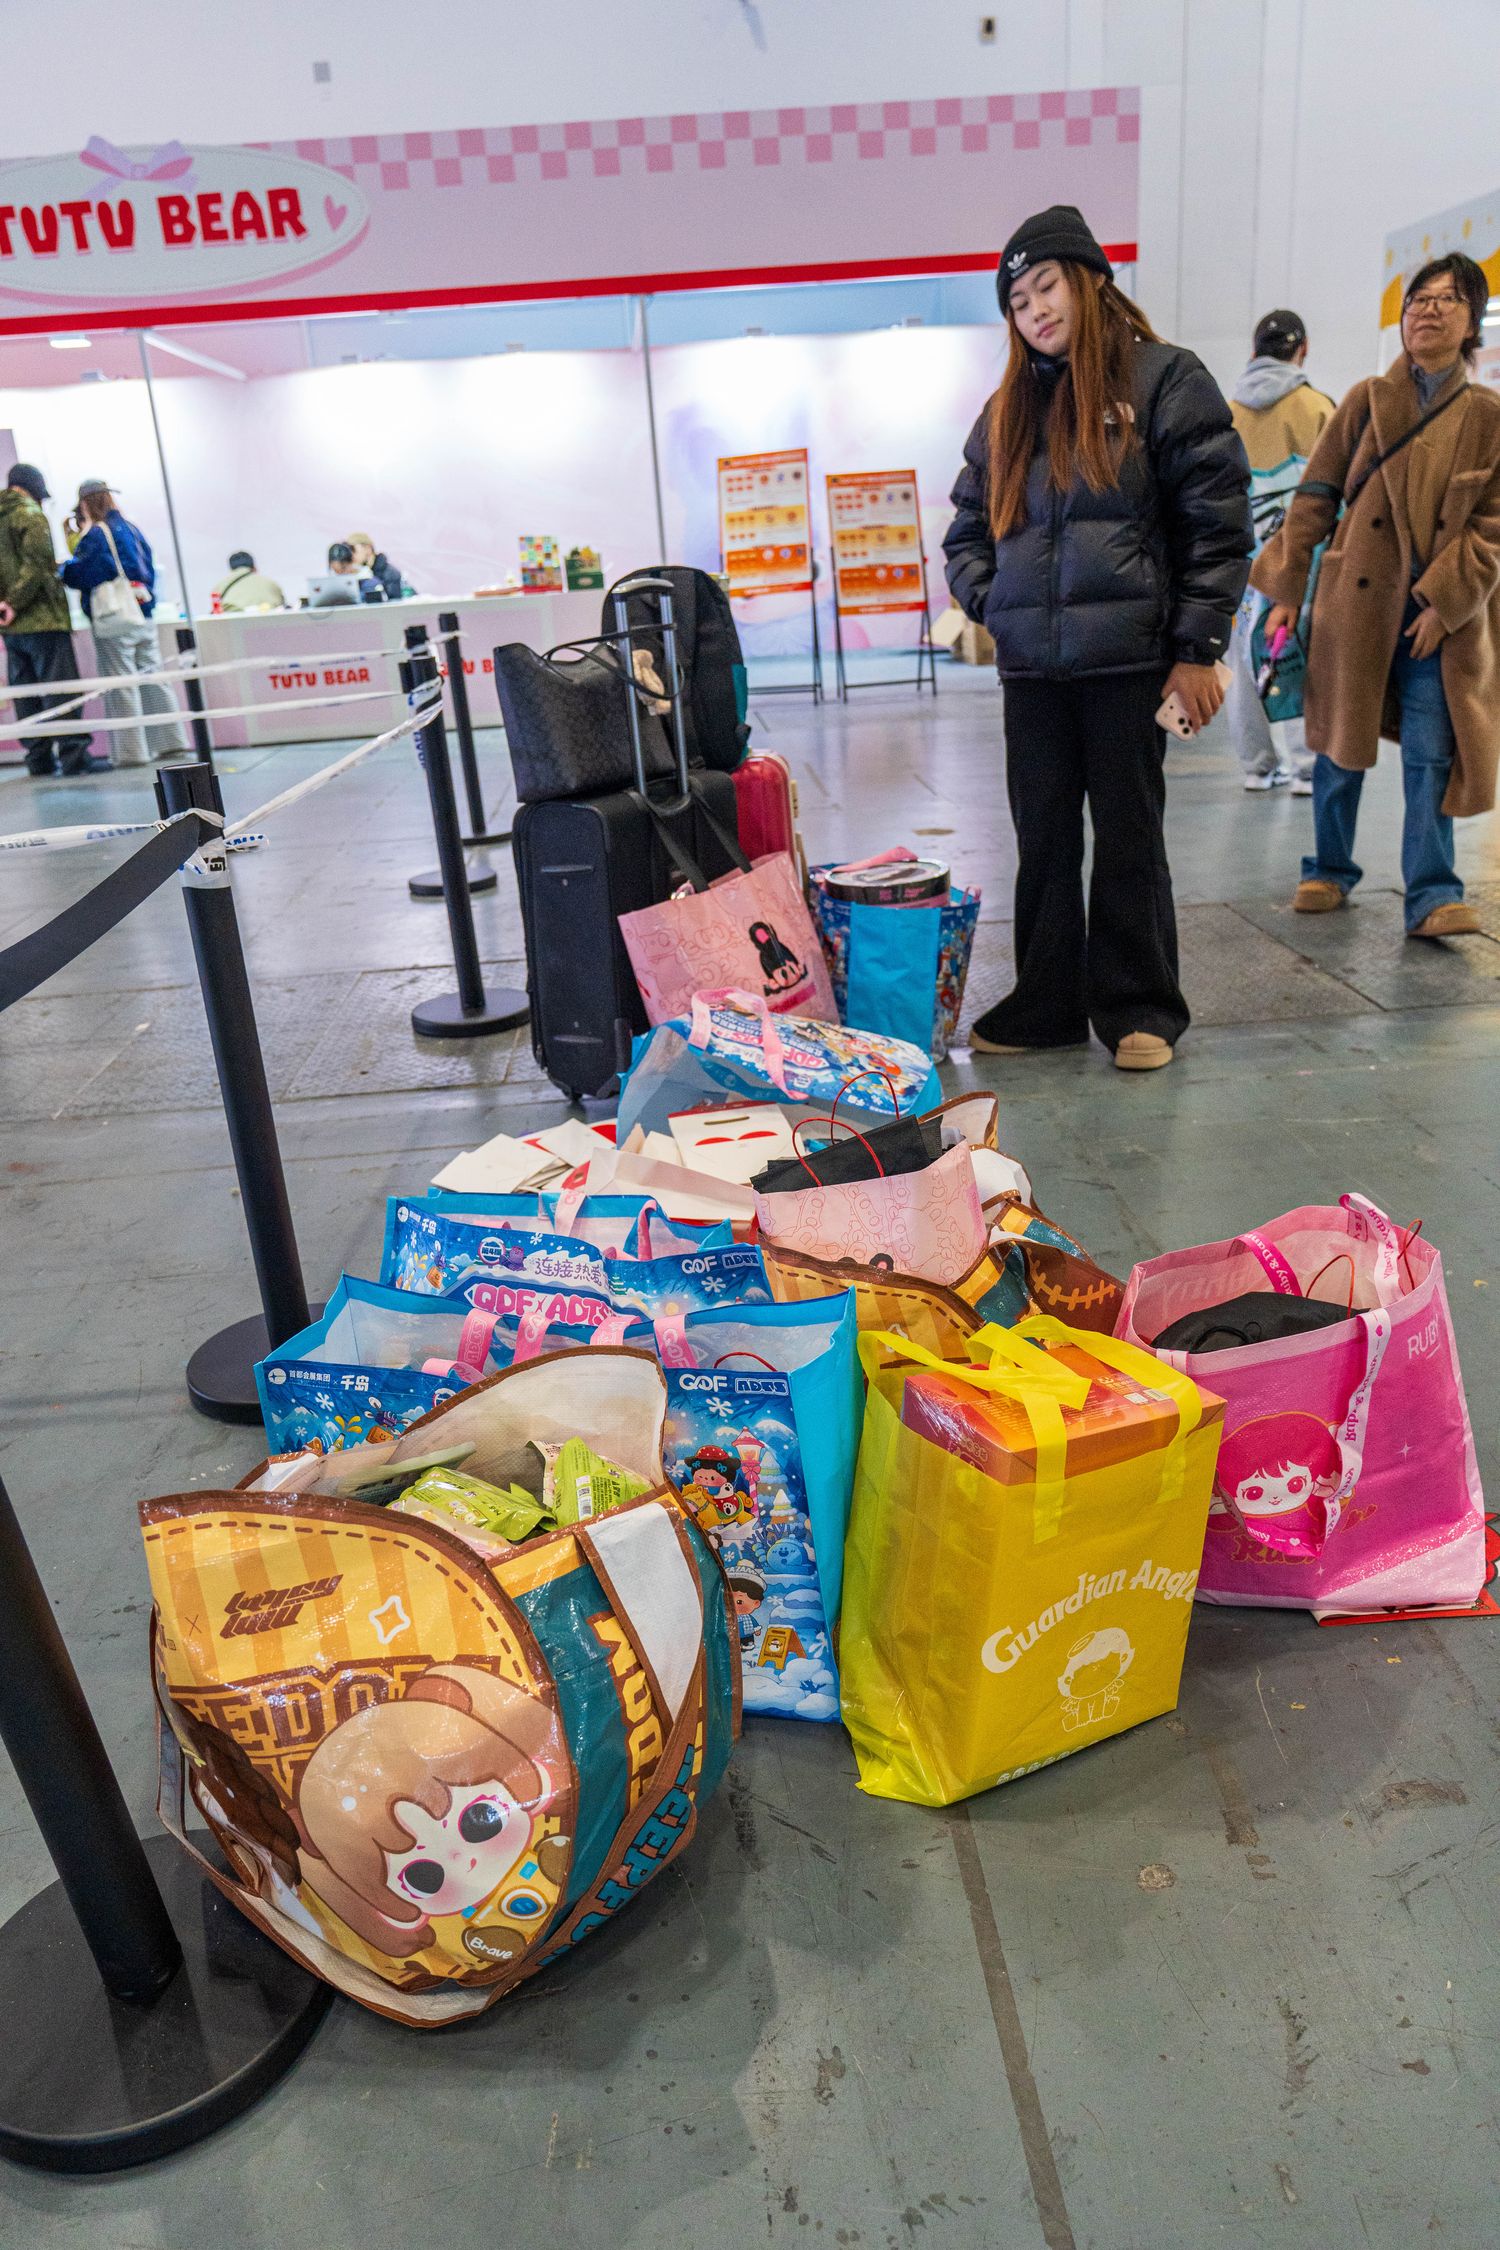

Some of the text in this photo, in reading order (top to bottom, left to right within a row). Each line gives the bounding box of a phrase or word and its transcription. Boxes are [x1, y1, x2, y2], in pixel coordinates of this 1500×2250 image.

[0, 187, 309, 255] TUTU BEAR
[269, 667, 371, 690] TUTU BEAR
[535, 1256, 603, 1287] 连接热爱
[473, 1282, 537, 1317] QDF
[340, 1374, 370, 1392] 千岛
[981, 1568, 1127, 1674] Guardian
[470, 1936, 513, 1960] Brave
